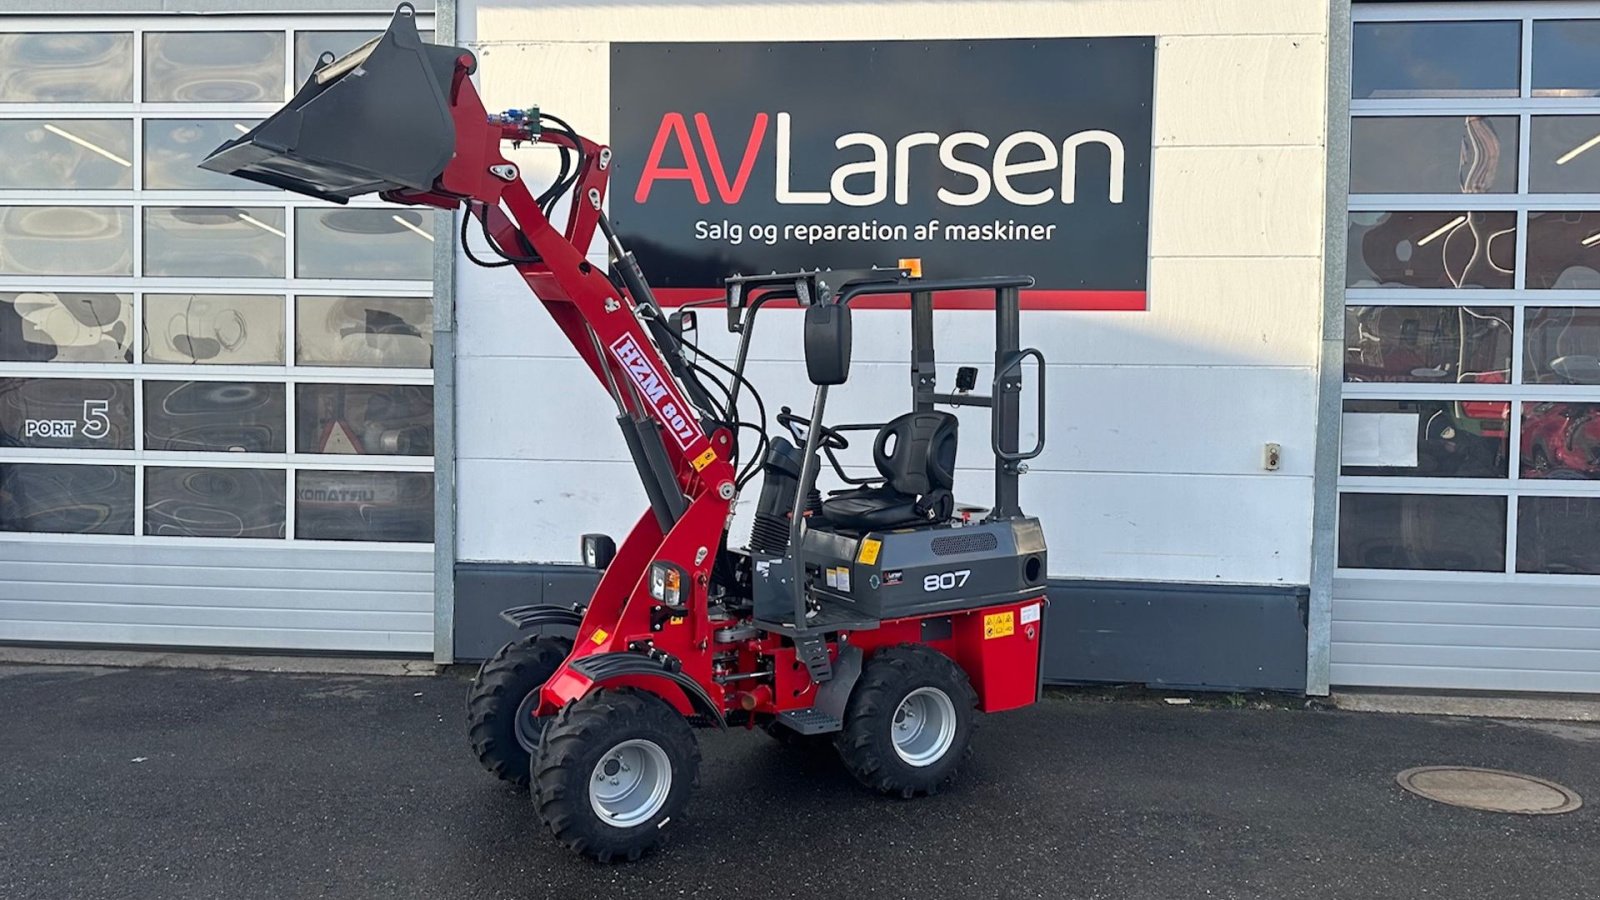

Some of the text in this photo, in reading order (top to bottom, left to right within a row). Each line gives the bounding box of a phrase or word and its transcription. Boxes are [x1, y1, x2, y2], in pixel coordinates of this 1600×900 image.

[695, 220, 1057, 245] Salg og reparation af maskiner
[617, 341, 694, 440] HZM 807
[25, 400, 111, 440] PORT 5
[924, 569, 972, 592] 807
